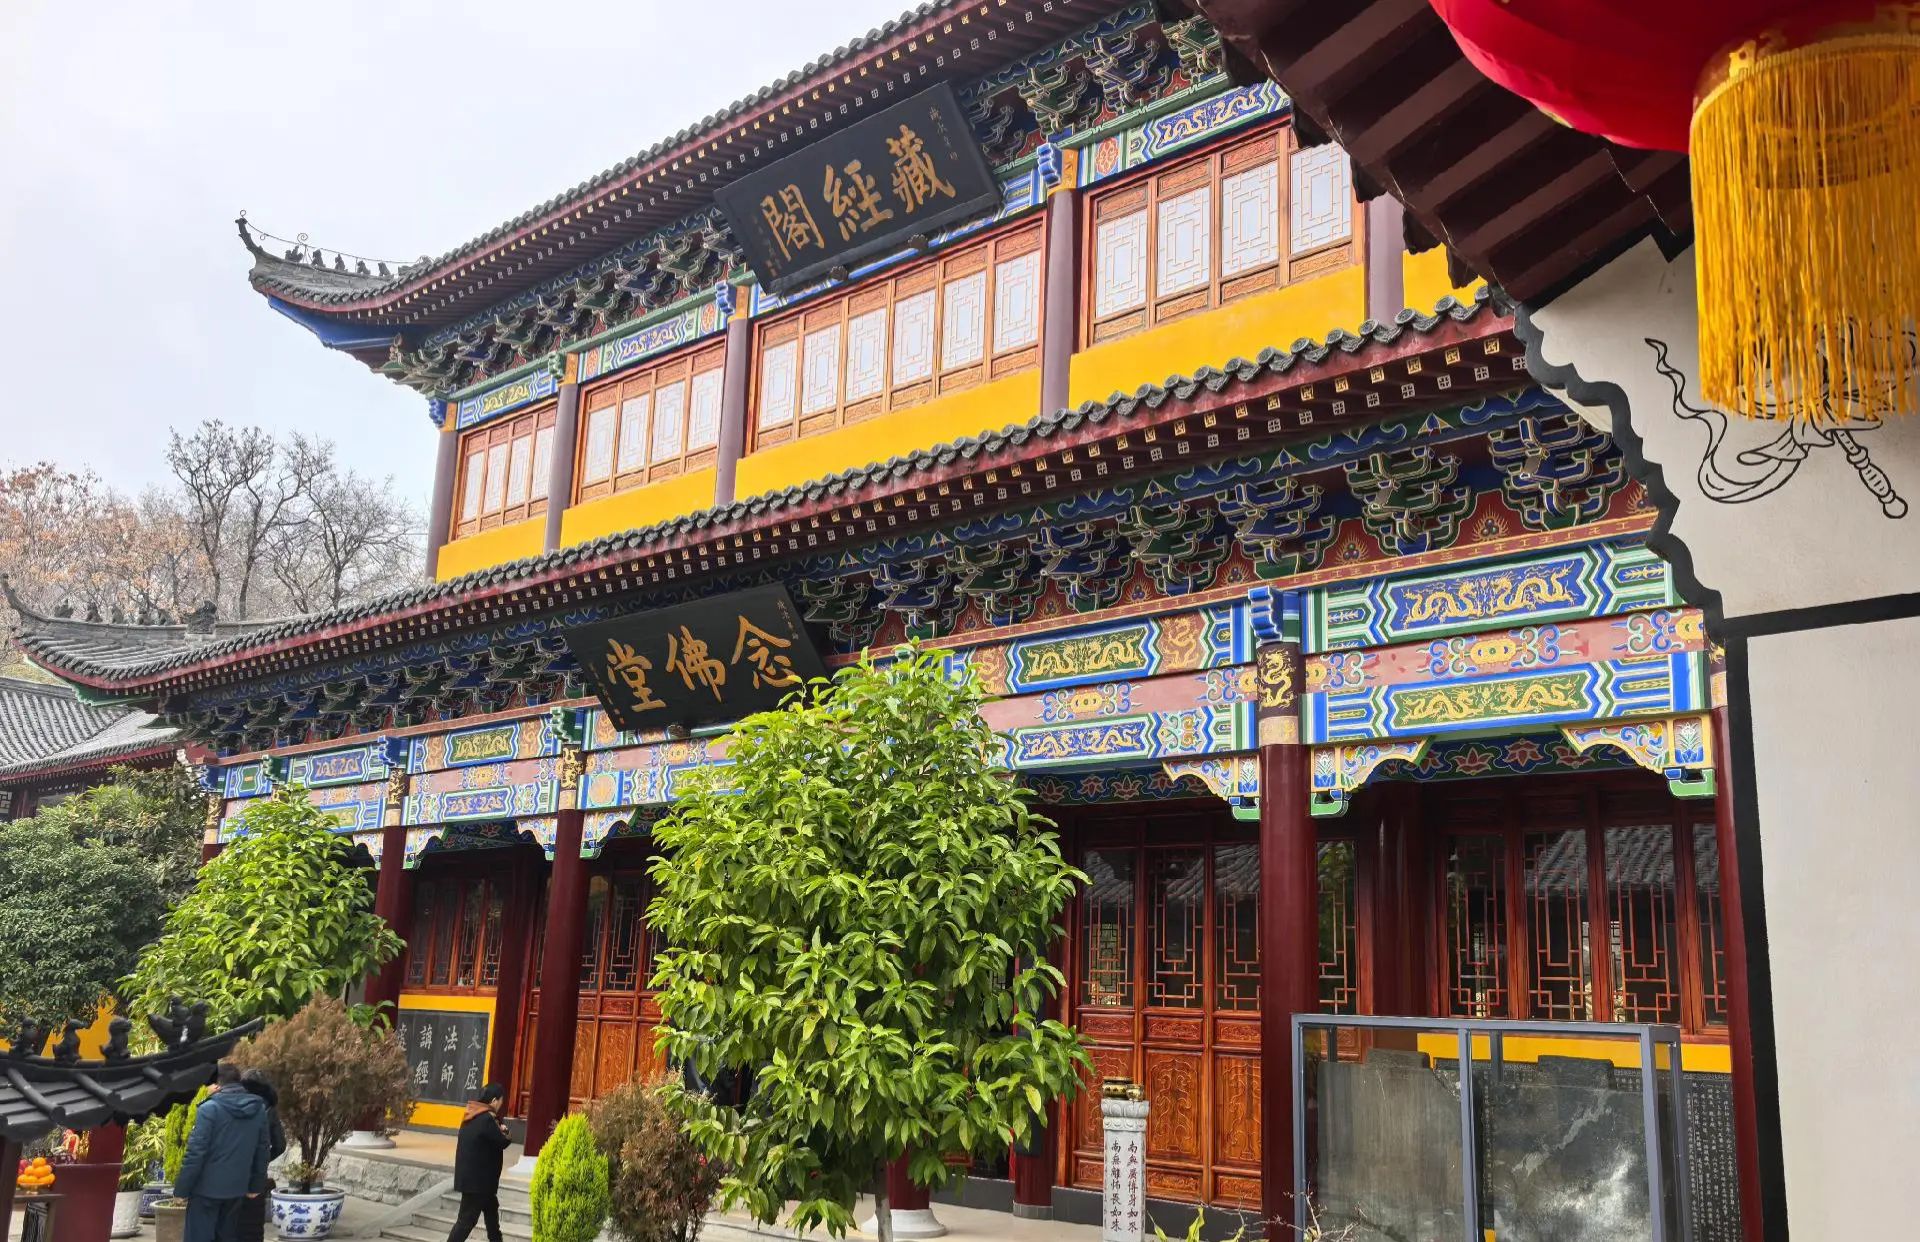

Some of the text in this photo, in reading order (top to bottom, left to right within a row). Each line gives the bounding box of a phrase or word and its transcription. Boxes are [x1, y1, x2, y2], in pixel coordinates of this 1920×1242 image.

[760, 123, 957, 263] 藏經閣
[606, 614, 799, 713] 念佛堂
